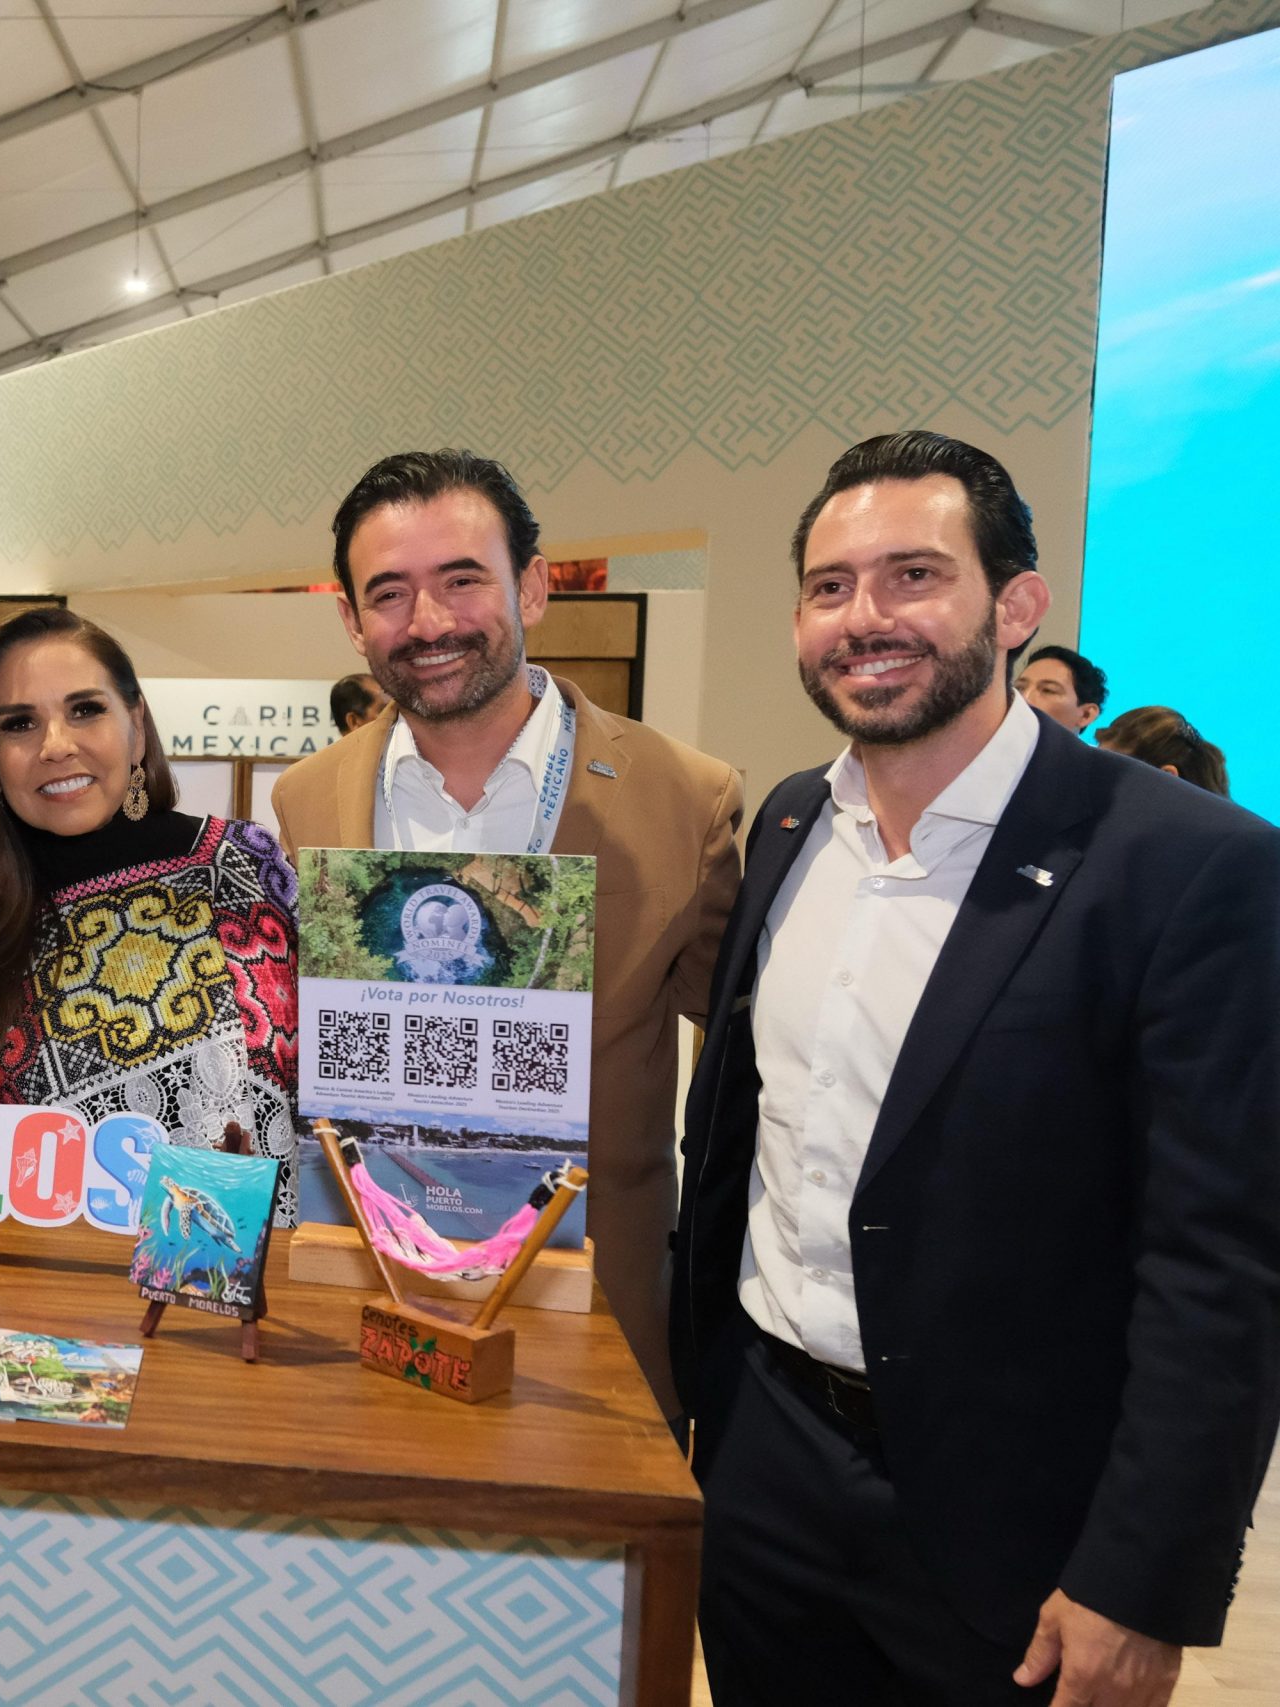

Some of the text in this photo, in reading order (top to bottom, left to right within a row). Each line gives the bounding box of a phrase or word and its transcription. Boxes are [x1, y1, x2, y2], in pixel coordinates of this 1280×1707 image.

[203, 705, 338, 727] CARIB
[539, 752, 556, 803] CARIBE
[543, 748, 569, 821] MEXICANO
[404, 885, 479, 940] WORLD TRAVEL AWARDS
[413, 940, 471, 952] NOMINEE
[426, 950, 454, 960] 2025
[361, 986, 525, 1008] ¡Vota por Nosotros!
[426, 1186, 461, 1198] HOLA
[426, 1196, 462, 1206] PUERTO
[426, 1204, 483, 1215] MORELOS.COM
[141, 1287, 239, 1317] PUERTO MORELOS
[361, 1325, 473, 1392] ZAPOTE
